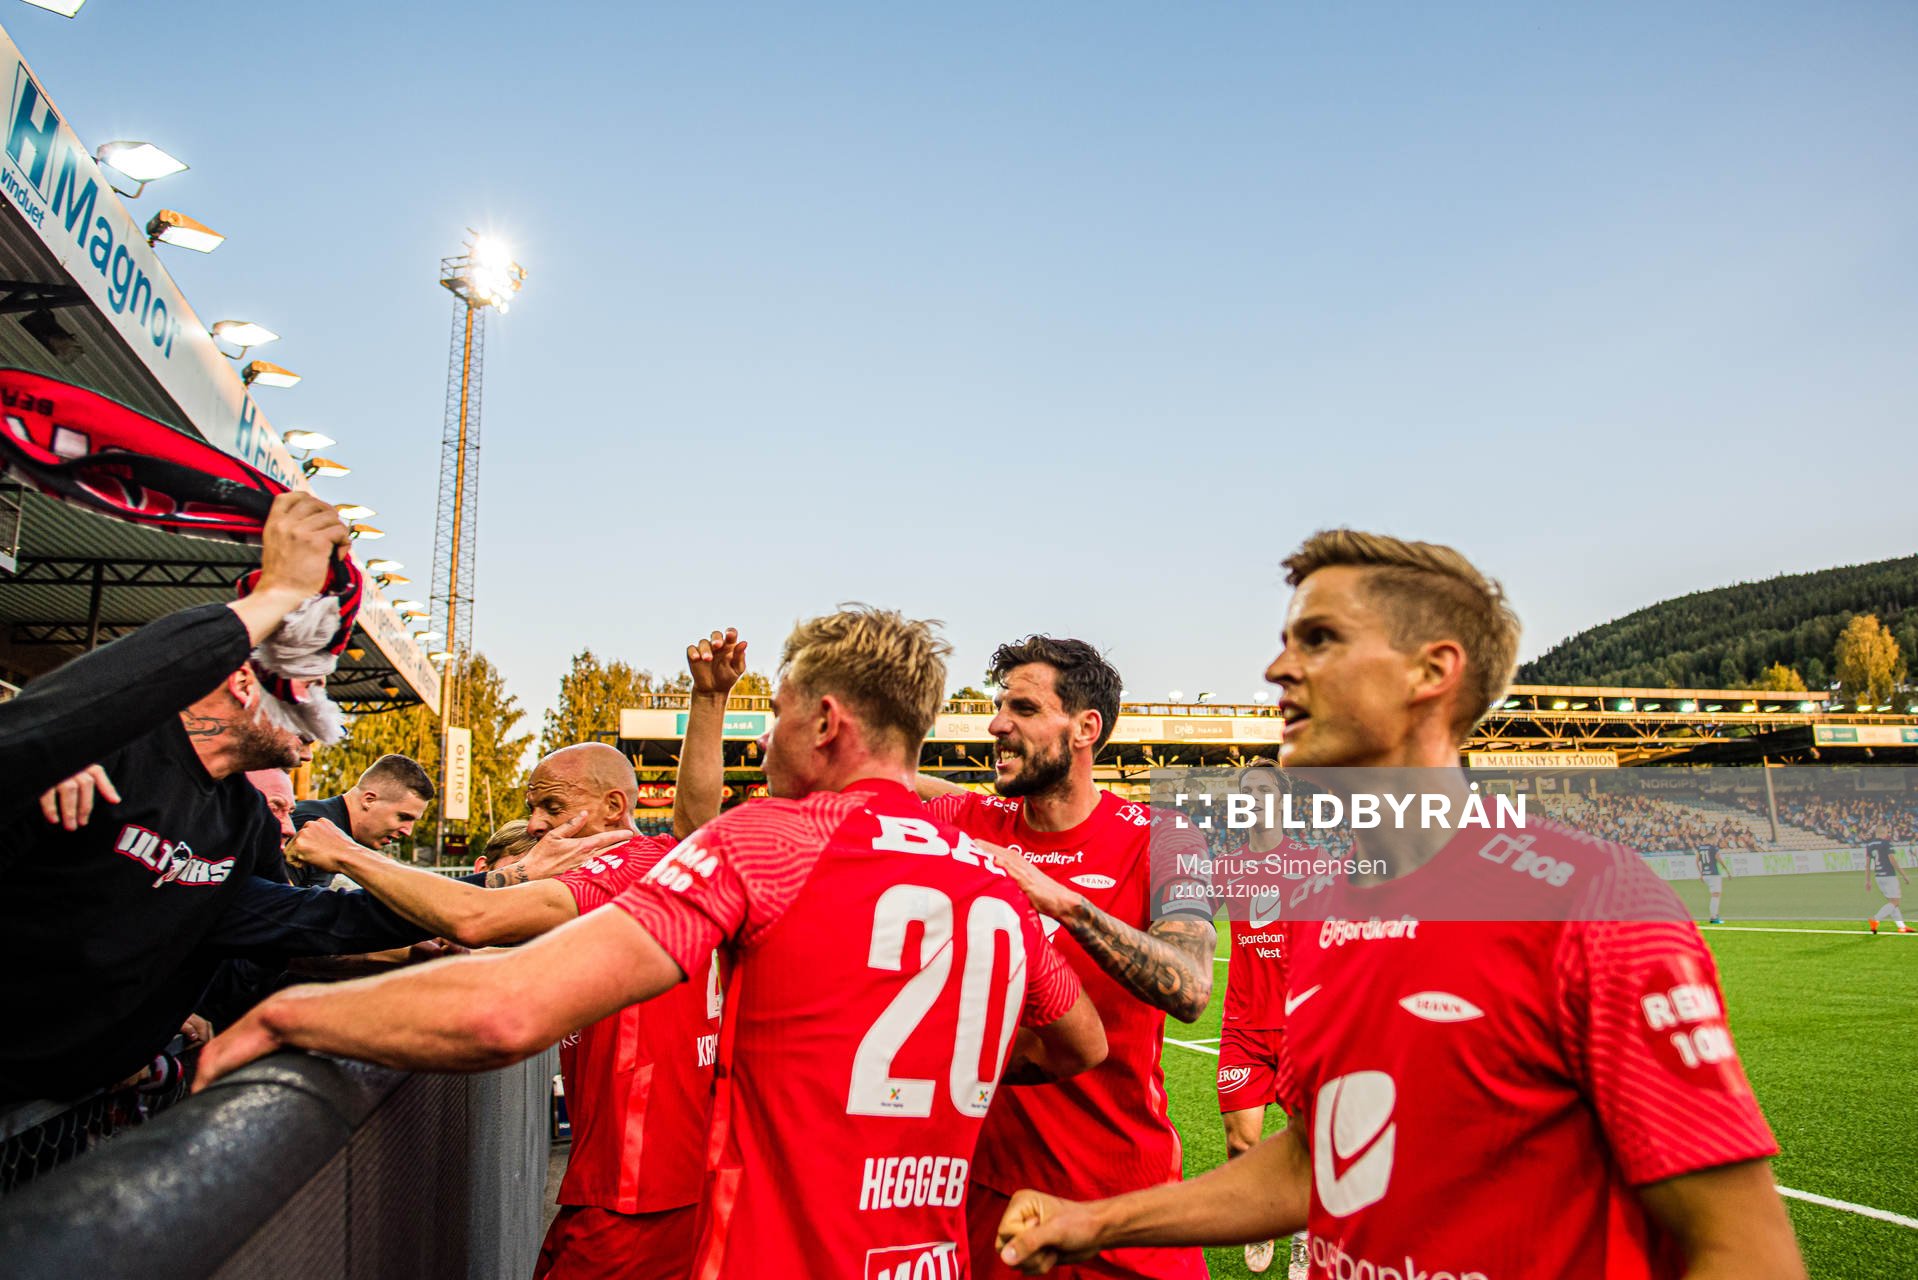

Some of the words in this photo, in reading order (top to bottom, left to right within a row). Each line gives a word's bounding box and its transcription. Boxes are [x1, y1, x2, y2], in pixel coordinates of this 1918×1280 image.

[1, 166, 45, 230] vinduet
[7, 77, 60, 190] H
[51, 144, 182, 359] Magnor
[1487, 754, 1561, 767] MARIENLYST
[1566, 754, 1615, 767] STADION
[1641, 778, 1697, 790] NORGIPS
[1256, 947, 1282, 958] Vest
[846, 883, 1028, 1118] 20
[1217, 1067, 1250, 1083] ERØY
[859, 1156, 968, 1210] HEGGEB
